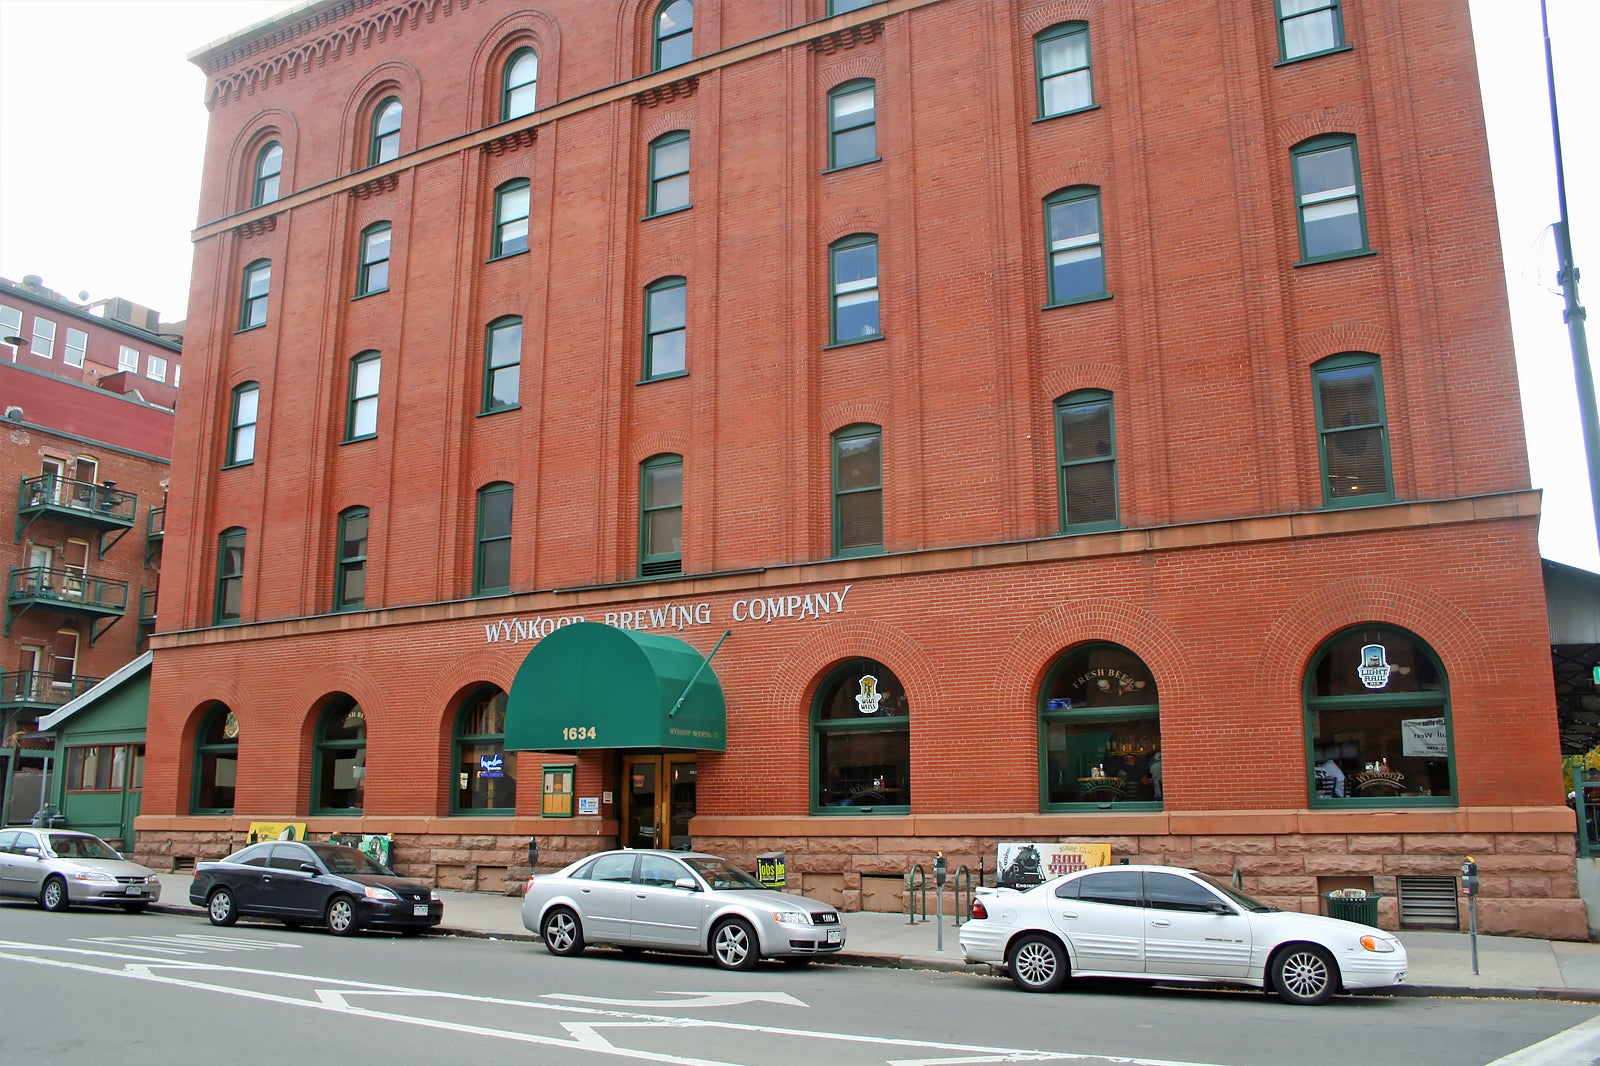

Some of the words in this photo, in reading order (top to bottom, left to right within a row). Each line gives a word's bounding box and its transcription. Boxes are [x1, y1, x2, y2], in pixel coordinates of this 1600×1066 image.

[605, 602, 711, 631] BREWING
[733, 585, 852, 624] COMPANY
[1072, 668, 1105, 689] FRESH
[1108, 668, 1135, 689] BEER
[562, 726, 597, 741] 1634
[758, 858, 775, 882] jobs
[775, 858, 785, 882] jobs
[1050, 854, 1086, 865] RAIL
